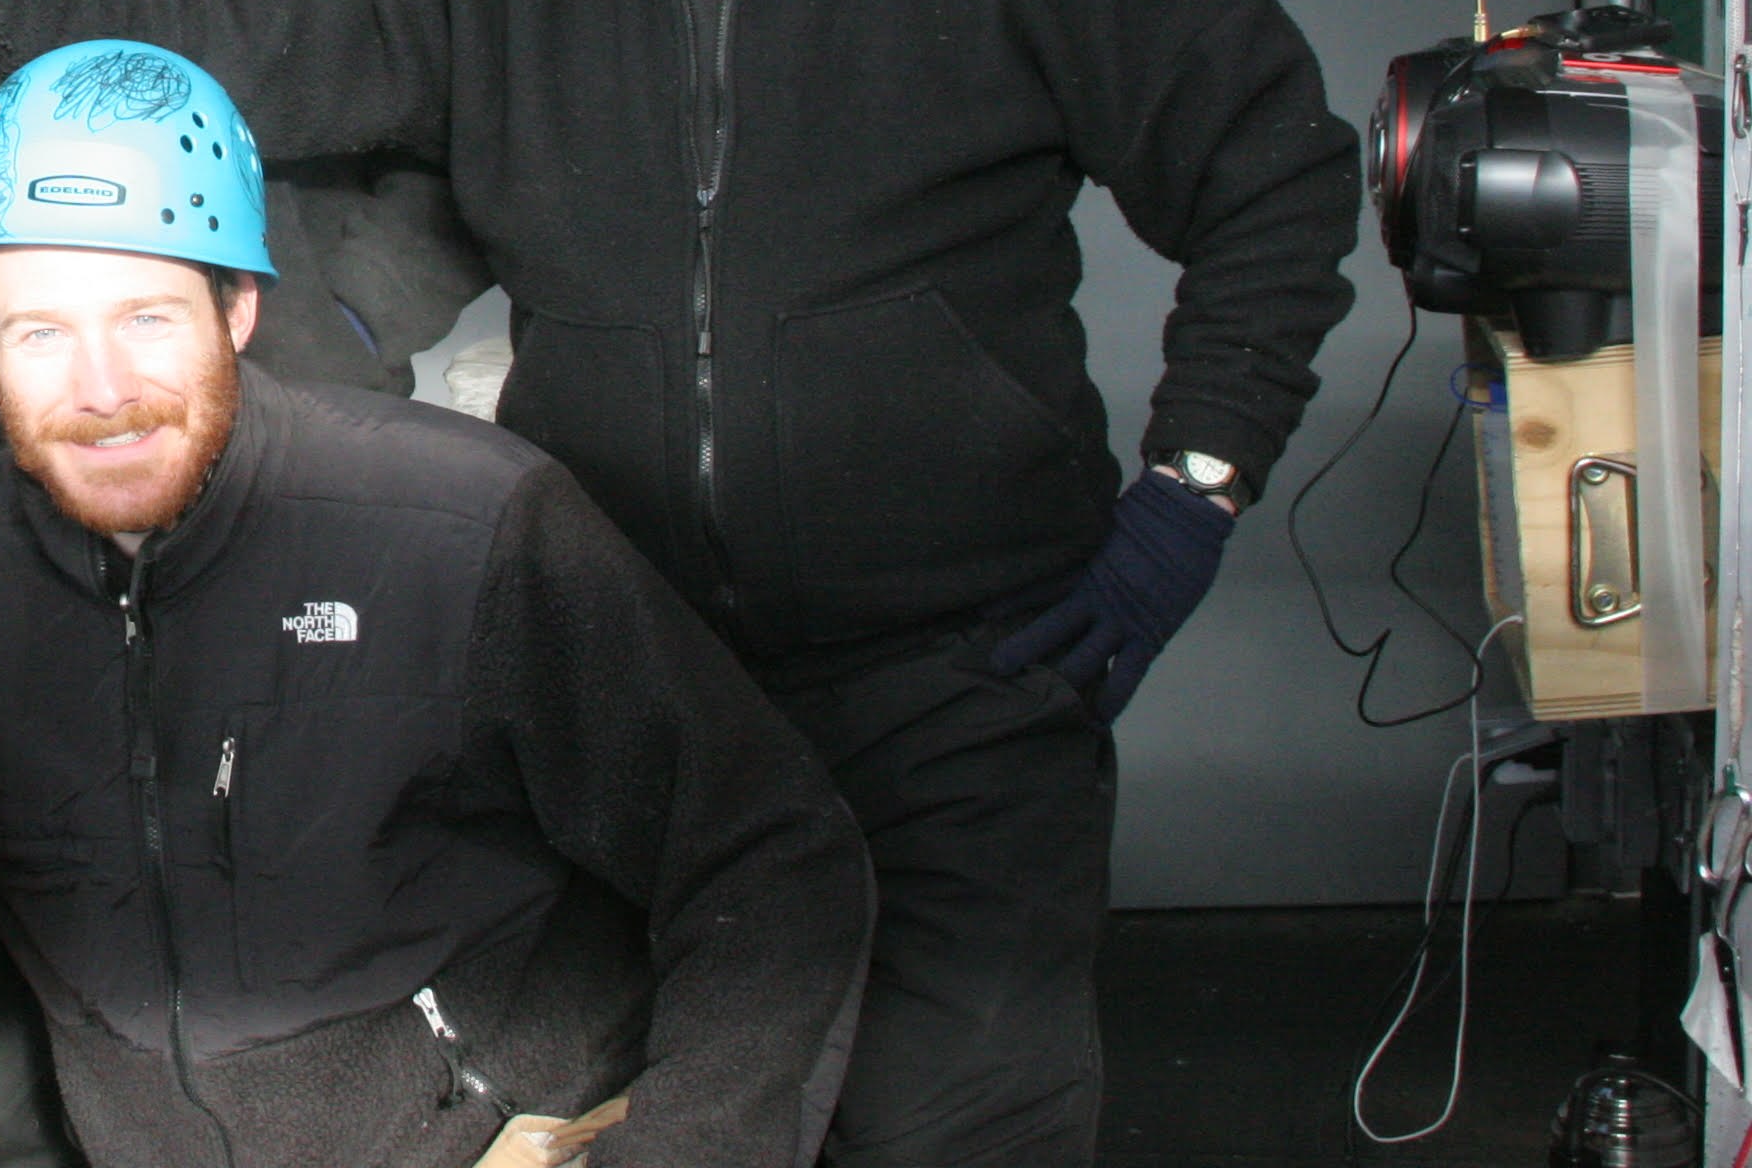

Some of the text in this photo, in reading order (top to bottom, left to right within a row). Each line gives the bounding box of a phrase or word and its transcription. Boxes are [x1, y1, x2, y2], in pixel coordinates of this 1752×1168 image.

[304, 601, 335, 616] THE
[282, 615, 335, 632] NORTH
[296, 628, 335, 643] FACE
